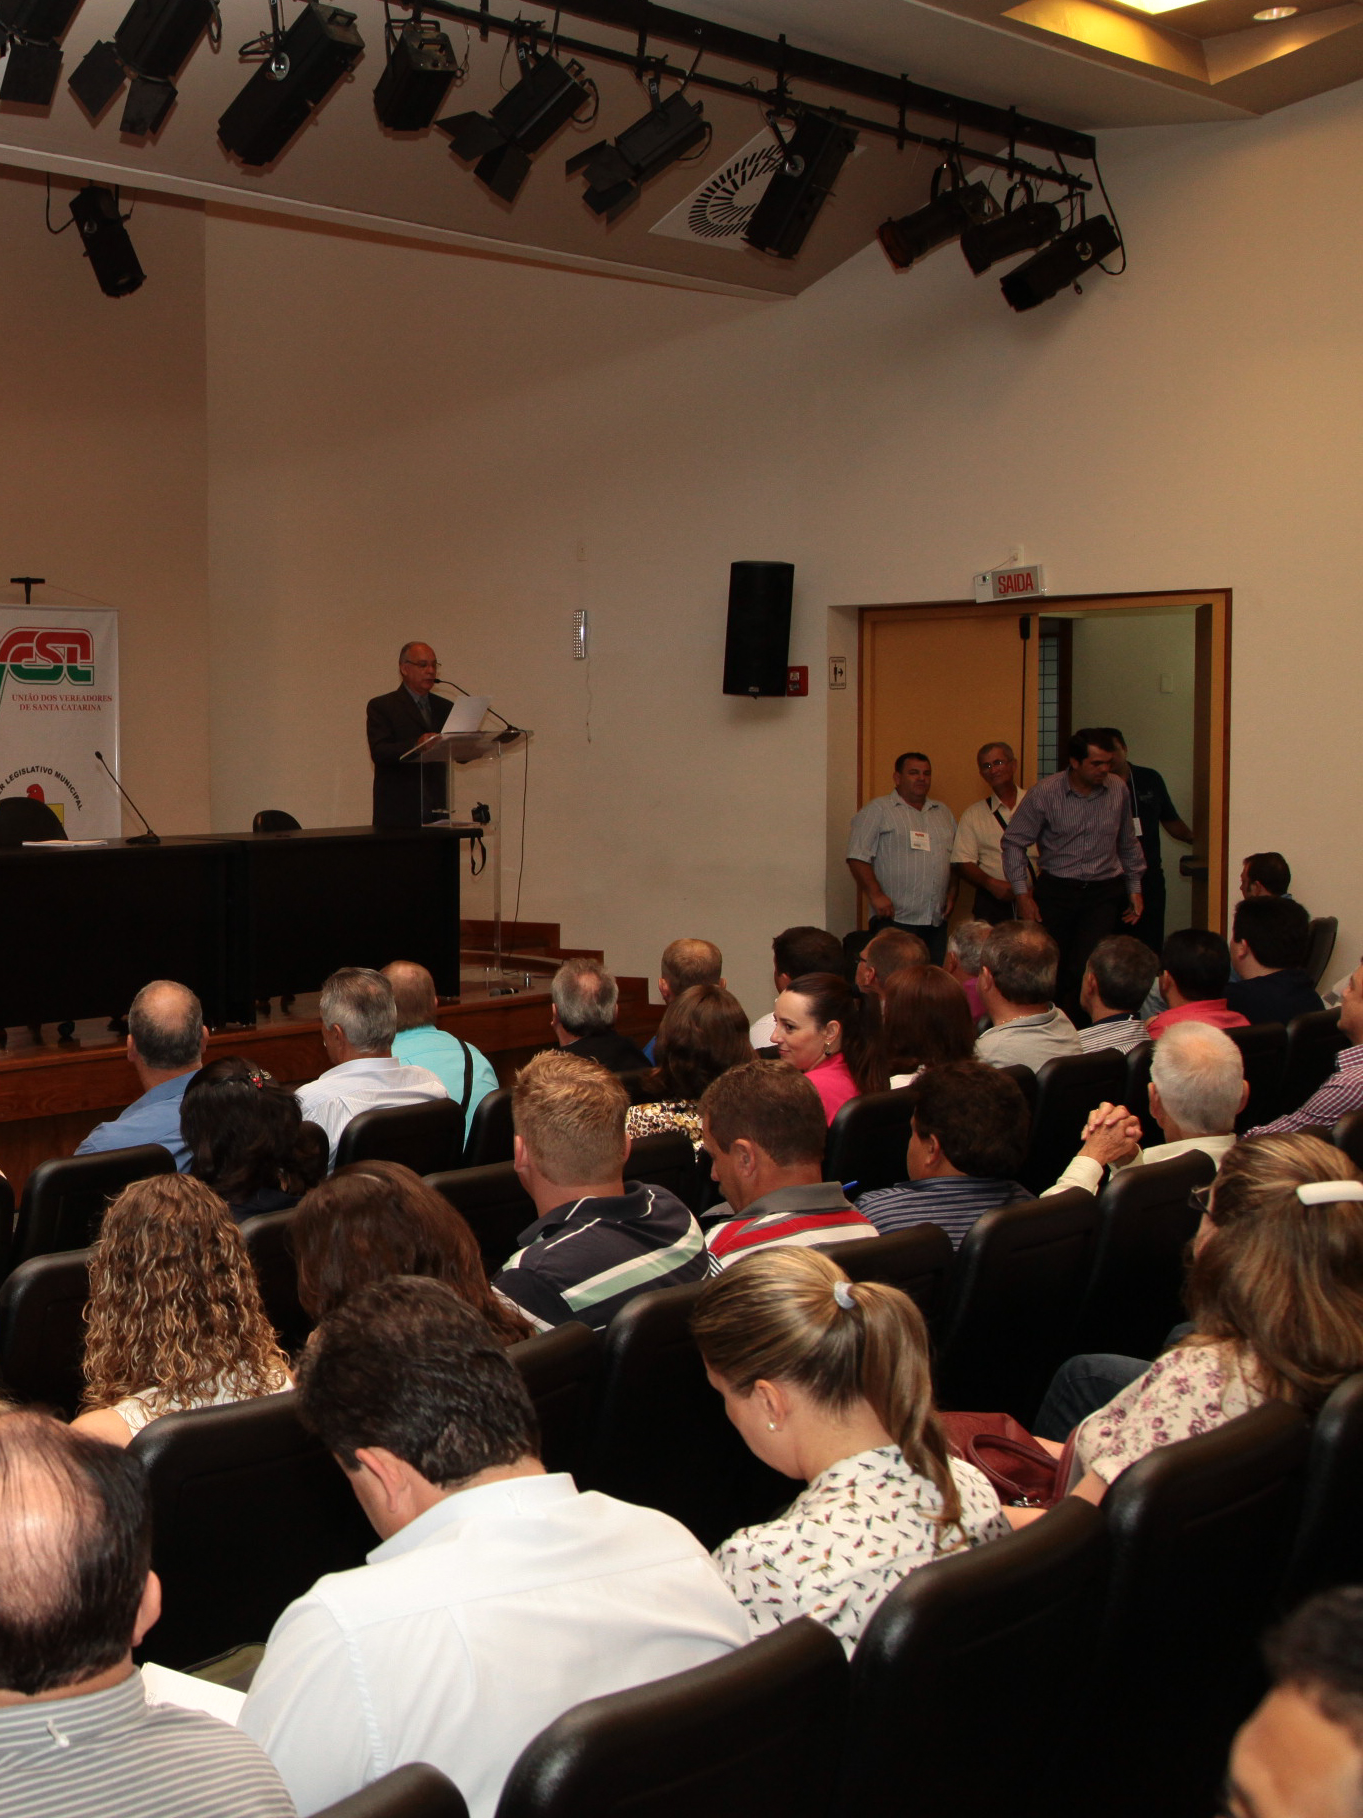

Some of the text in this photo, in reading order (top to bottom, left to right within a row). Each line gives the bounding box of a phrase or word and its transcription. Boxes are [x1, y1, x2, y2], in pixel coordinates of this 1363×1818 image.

[12, 693, 112, 702] UNIÃO DOS VEREADORES
[5, 766, 53, 784] LEGISLATIVO
[55, 771, 83, 811] MUNICIPAL
